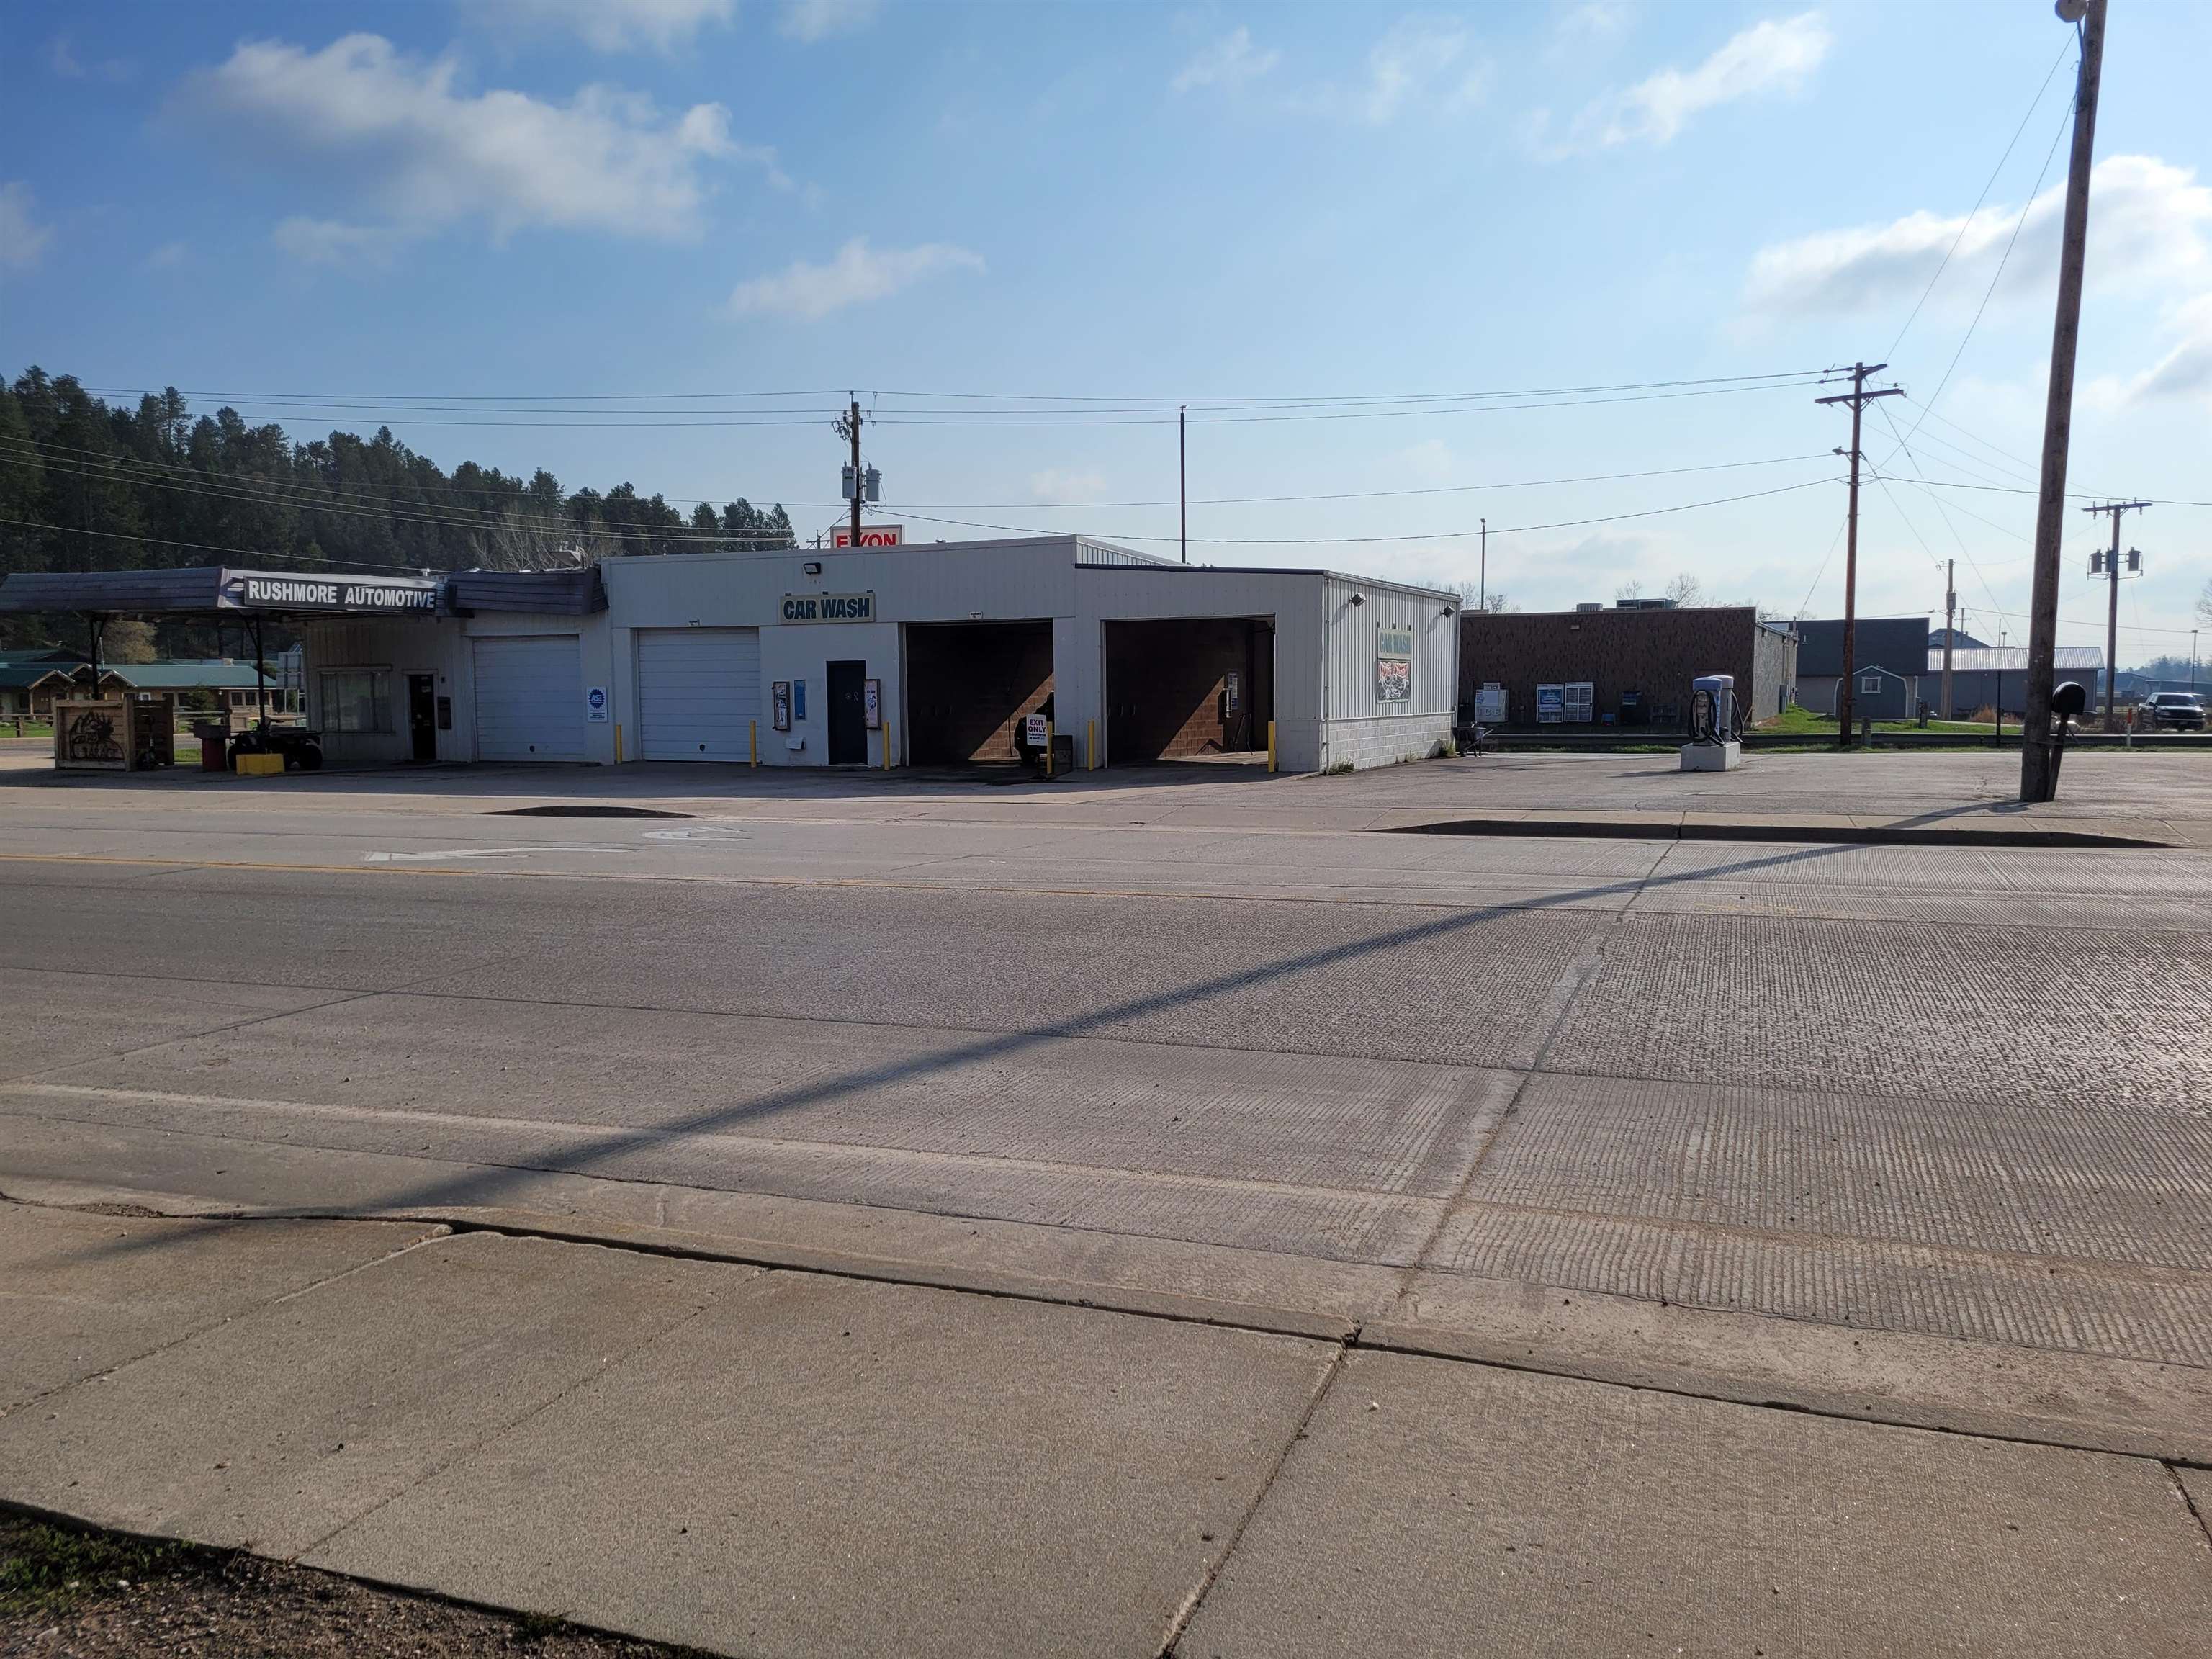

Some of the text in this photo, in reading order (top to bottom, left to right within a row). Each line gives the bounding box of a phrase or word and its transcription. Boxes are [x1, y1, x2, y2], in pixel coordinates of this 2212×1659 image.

[248, 580, 436, 608] RUSHMORE AUTOMOTIVE
[783, 598, 870, 619] CAR WASH
[1379, 632, 1411, 653] CAR WASH
